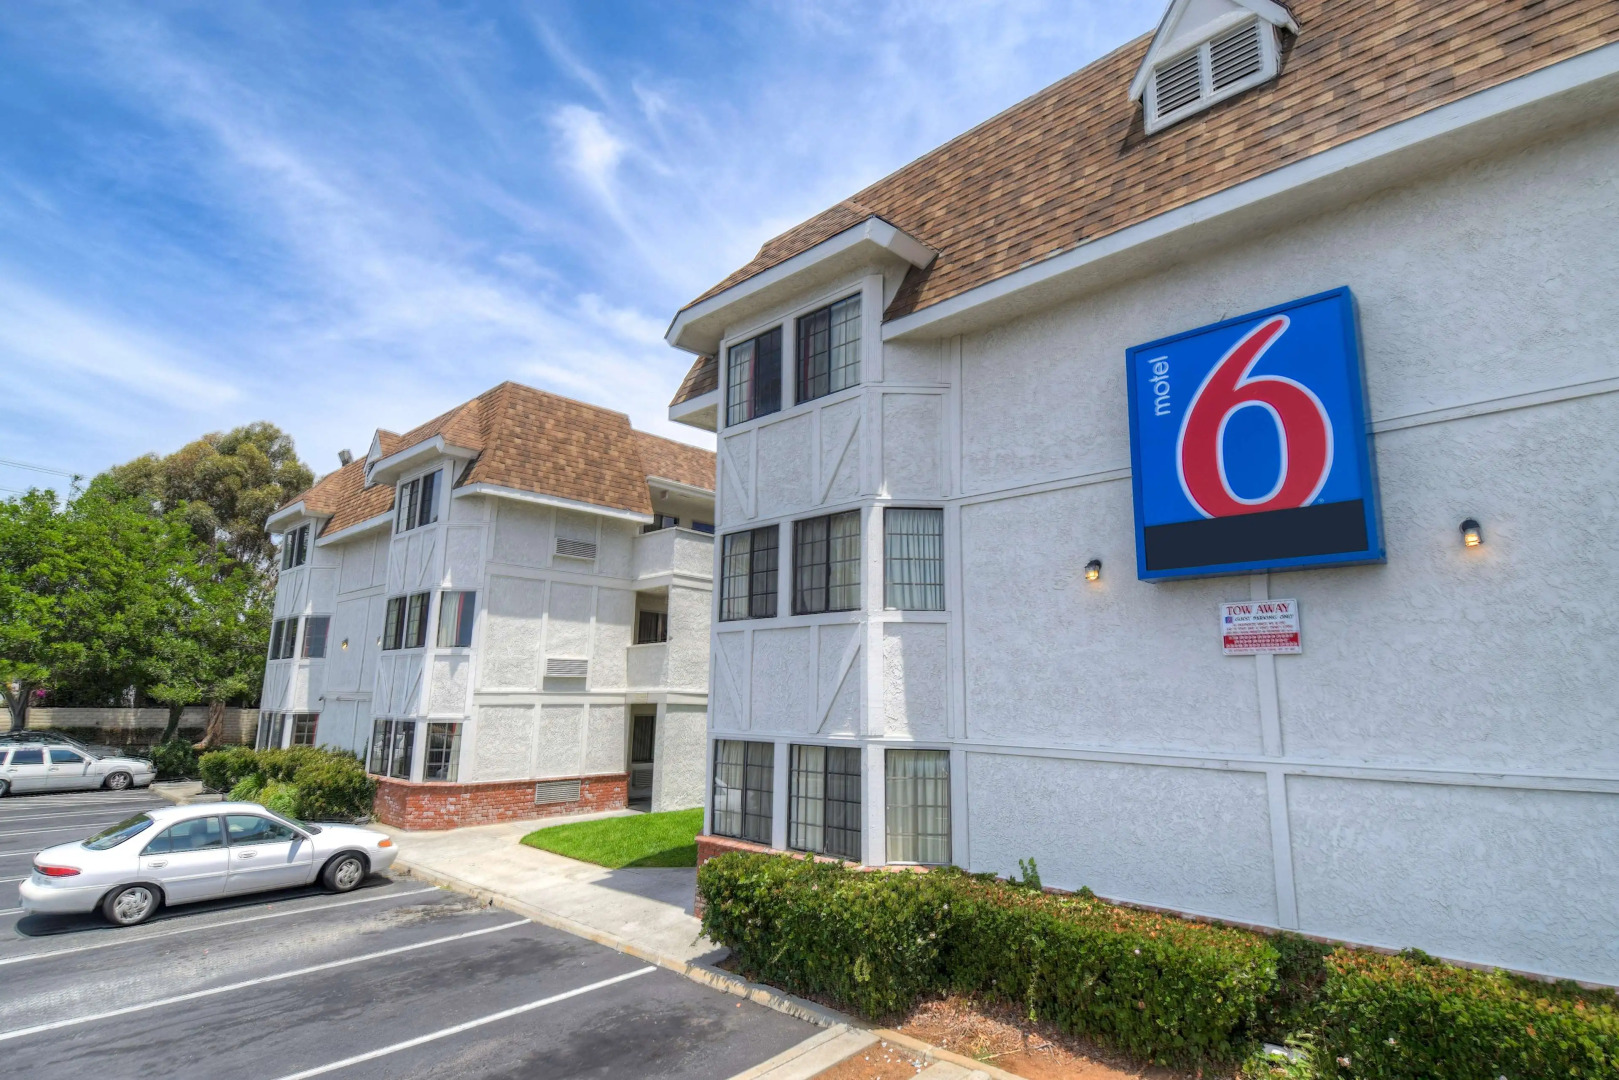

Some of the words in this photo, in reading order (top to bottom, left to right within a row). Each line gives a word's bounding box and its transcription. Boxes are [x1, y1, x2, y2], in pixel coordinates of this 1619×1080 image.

[1147, 355, 1171, 417] motel
[1175, 314, 1334, 519] 6
[1226, 605, 1252, 615] TOW
[1257, 603, 1290, 614] AWAY
